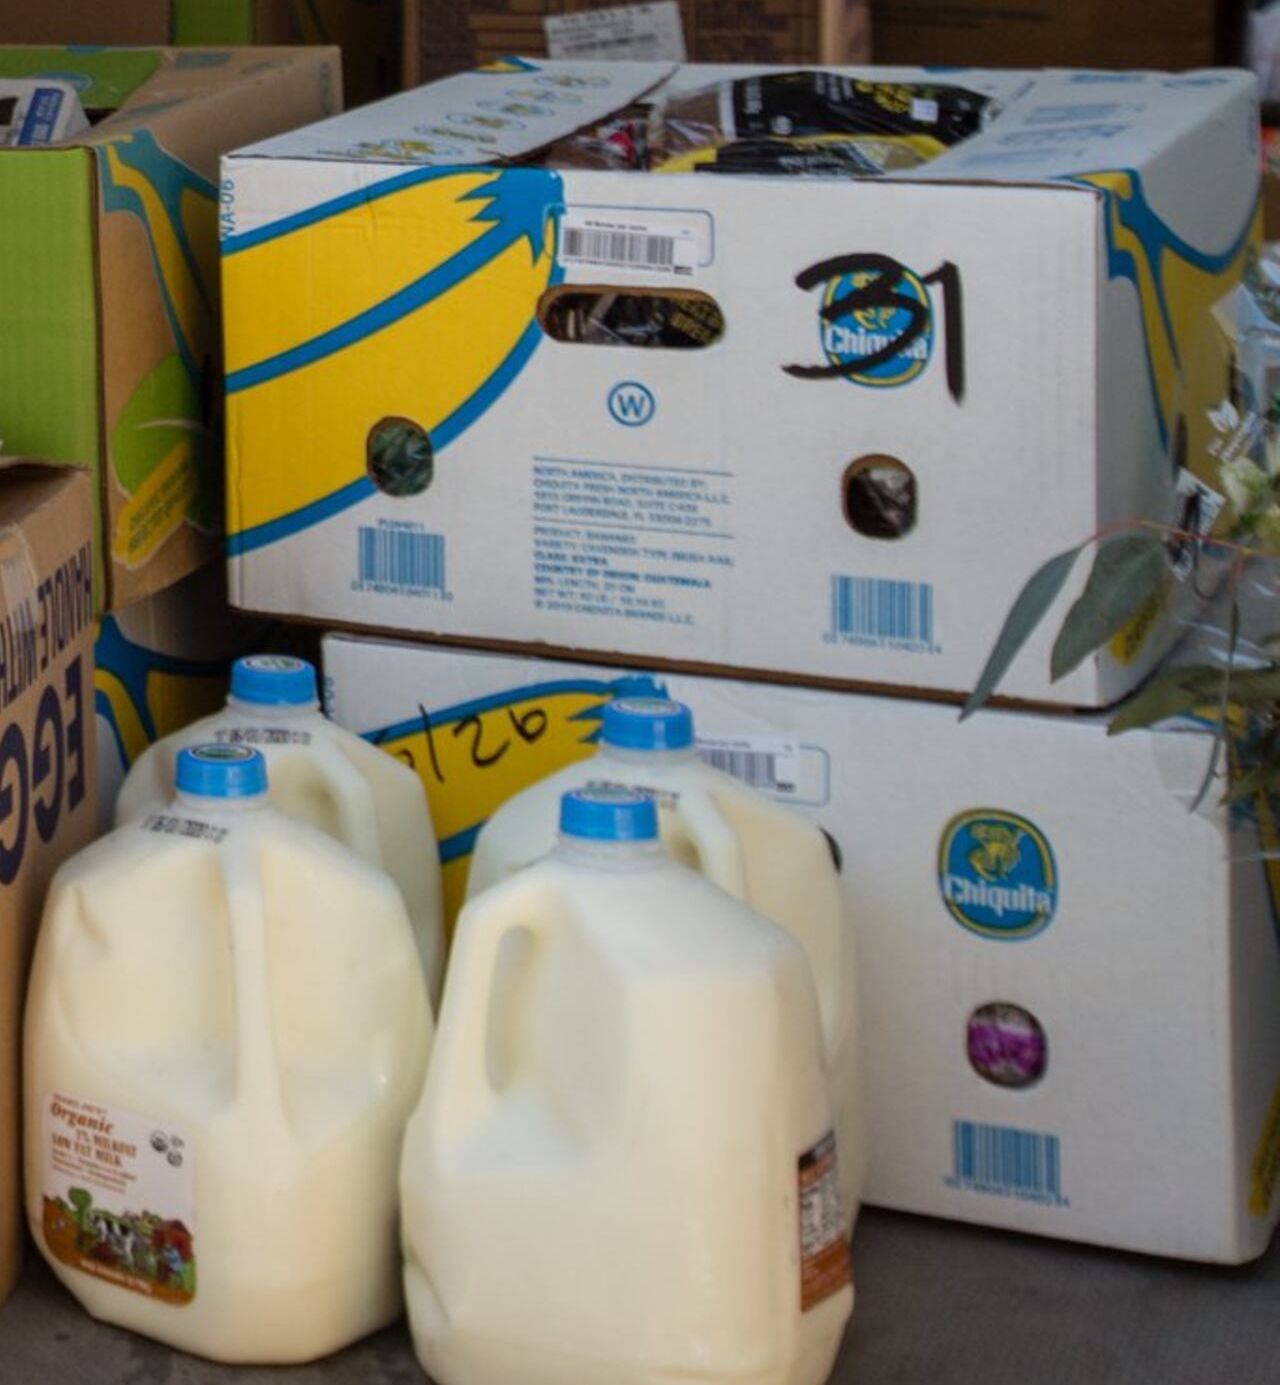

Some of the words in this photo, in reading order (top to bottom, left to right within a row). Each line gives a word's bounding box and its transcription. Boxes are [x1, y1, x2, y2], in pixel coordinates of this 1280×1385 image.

[780, 253, 966, 407] 31
[943, 874, 1051, 918] Chiquita
[50, 1101, 114, 1135] Organic
